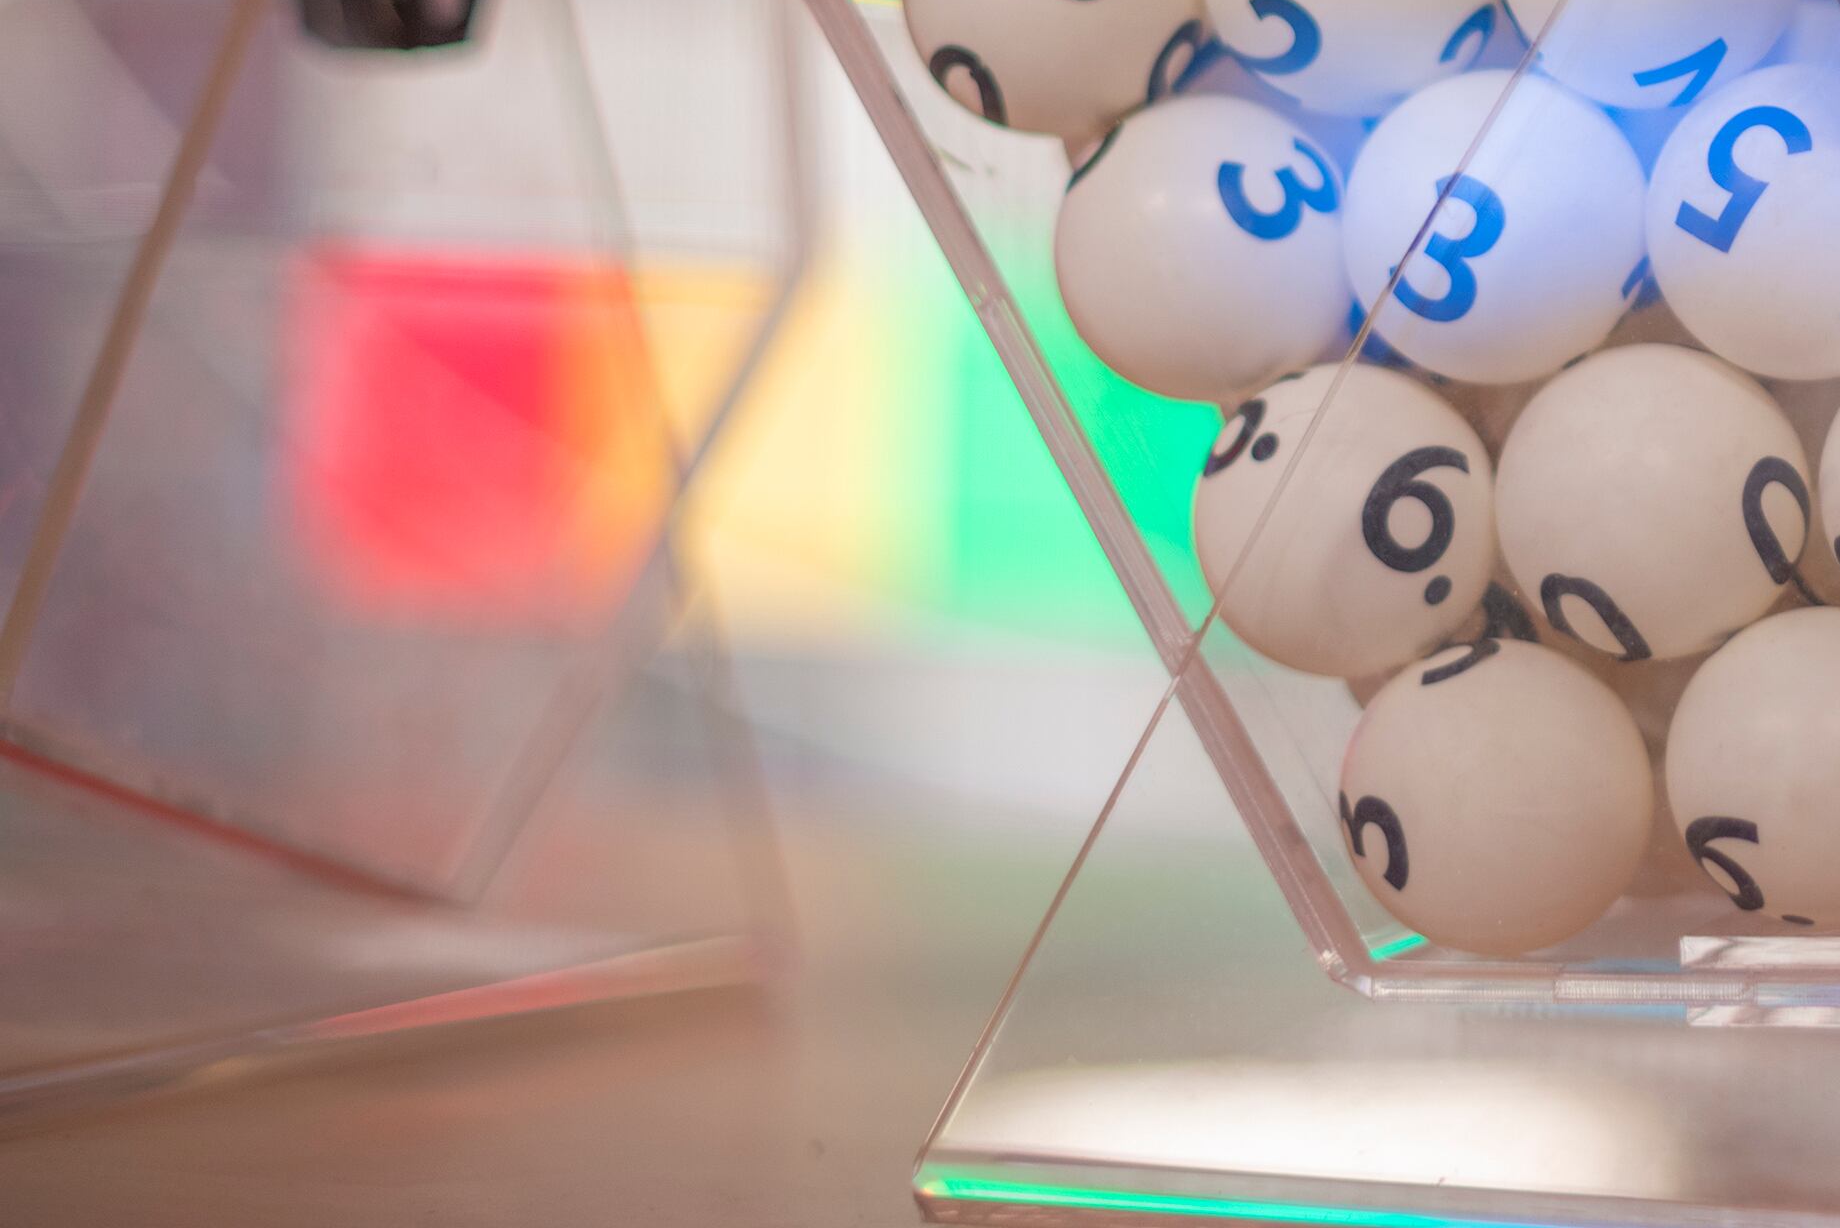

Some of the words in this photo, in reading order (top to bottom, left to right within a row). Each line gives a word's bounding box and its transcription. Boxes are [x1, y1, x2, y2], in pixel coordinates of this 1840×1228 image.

[1217, 136, 1341, 240] 3
[1389, 172, 1507, 323] 3
[1676, 105, 1813, 254] 5
